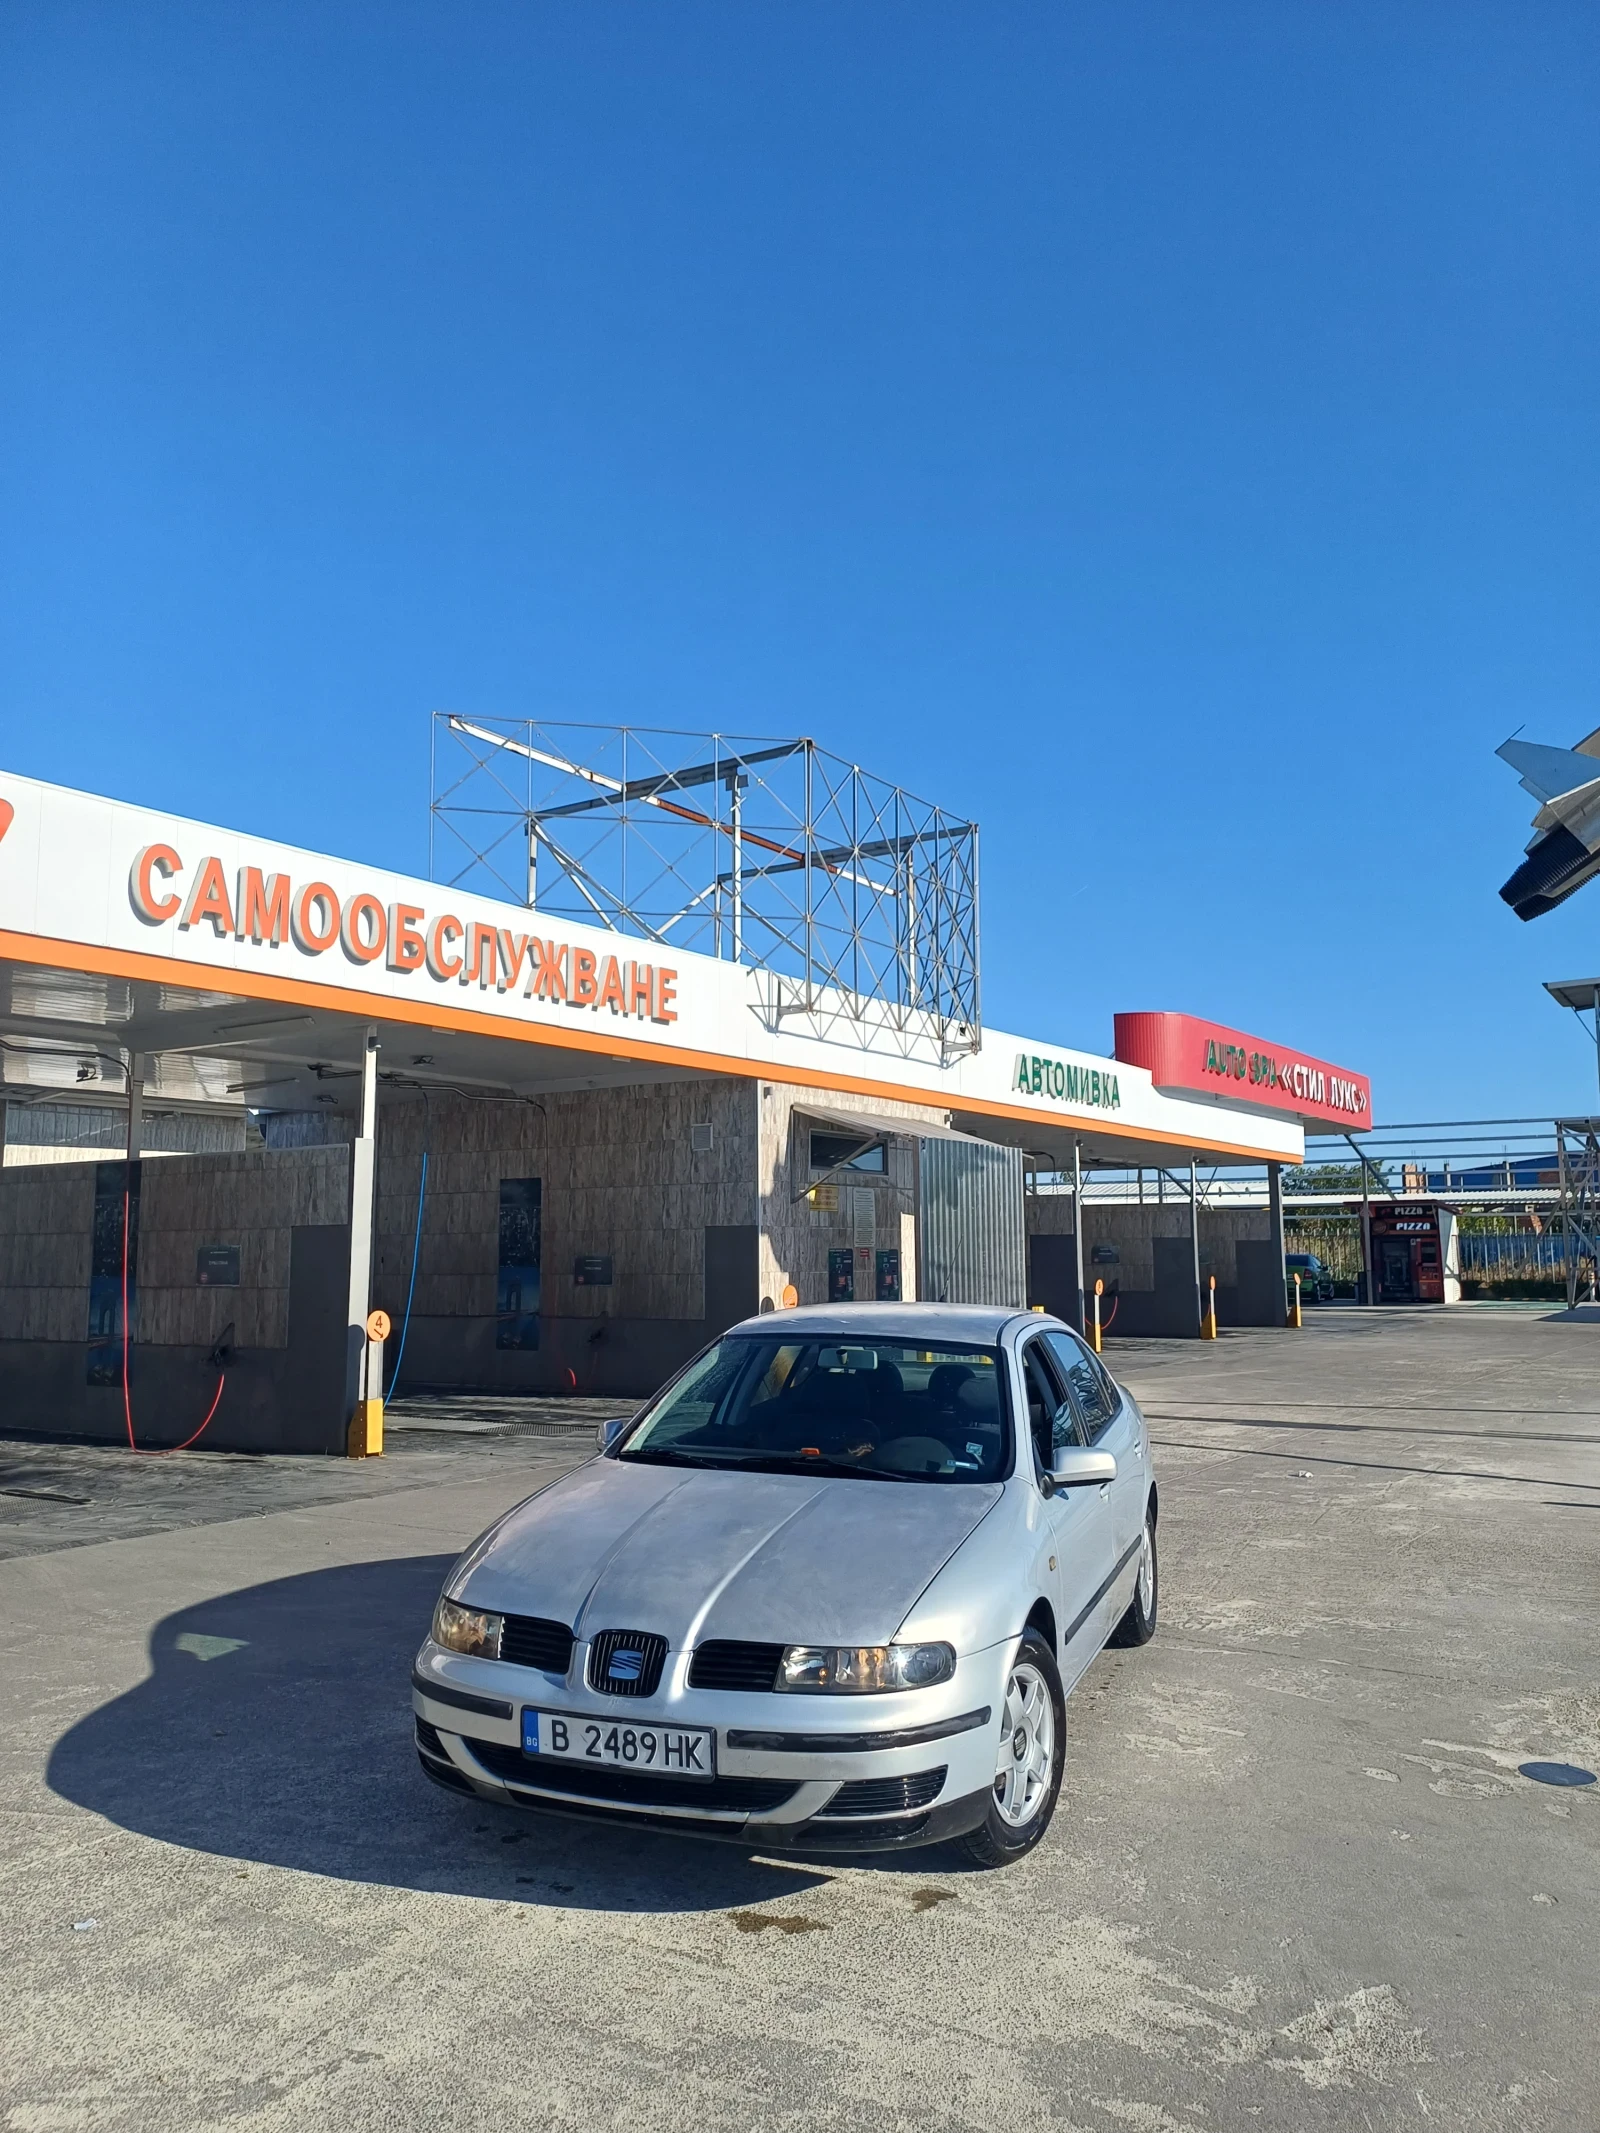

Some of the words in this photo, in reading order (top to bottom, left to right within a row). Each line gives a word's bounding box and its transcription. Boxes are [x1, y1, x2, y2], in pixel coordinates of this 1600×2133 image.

[131, 842, 678, 1022] САМООБСЛУЖВАНЕ
[1014, 1053, 1121, 1108] АВТОМИВКА
[1204, 1039, 1247, 1079] AUTO
[1250, 1051, 1277, 1088] SPA
[1394, 1206, 1423, 1215] PIZZA
[1395, 1222, 1431, 1231] PIZZA
[375, 1315, 383, 1328] 4
[526, 1736, 538, 1747] BG
[551, 1719, 570, 1751] B
[585, 1725, 658, 1764] 2489
[664, 1733, 704, 1770] HK
